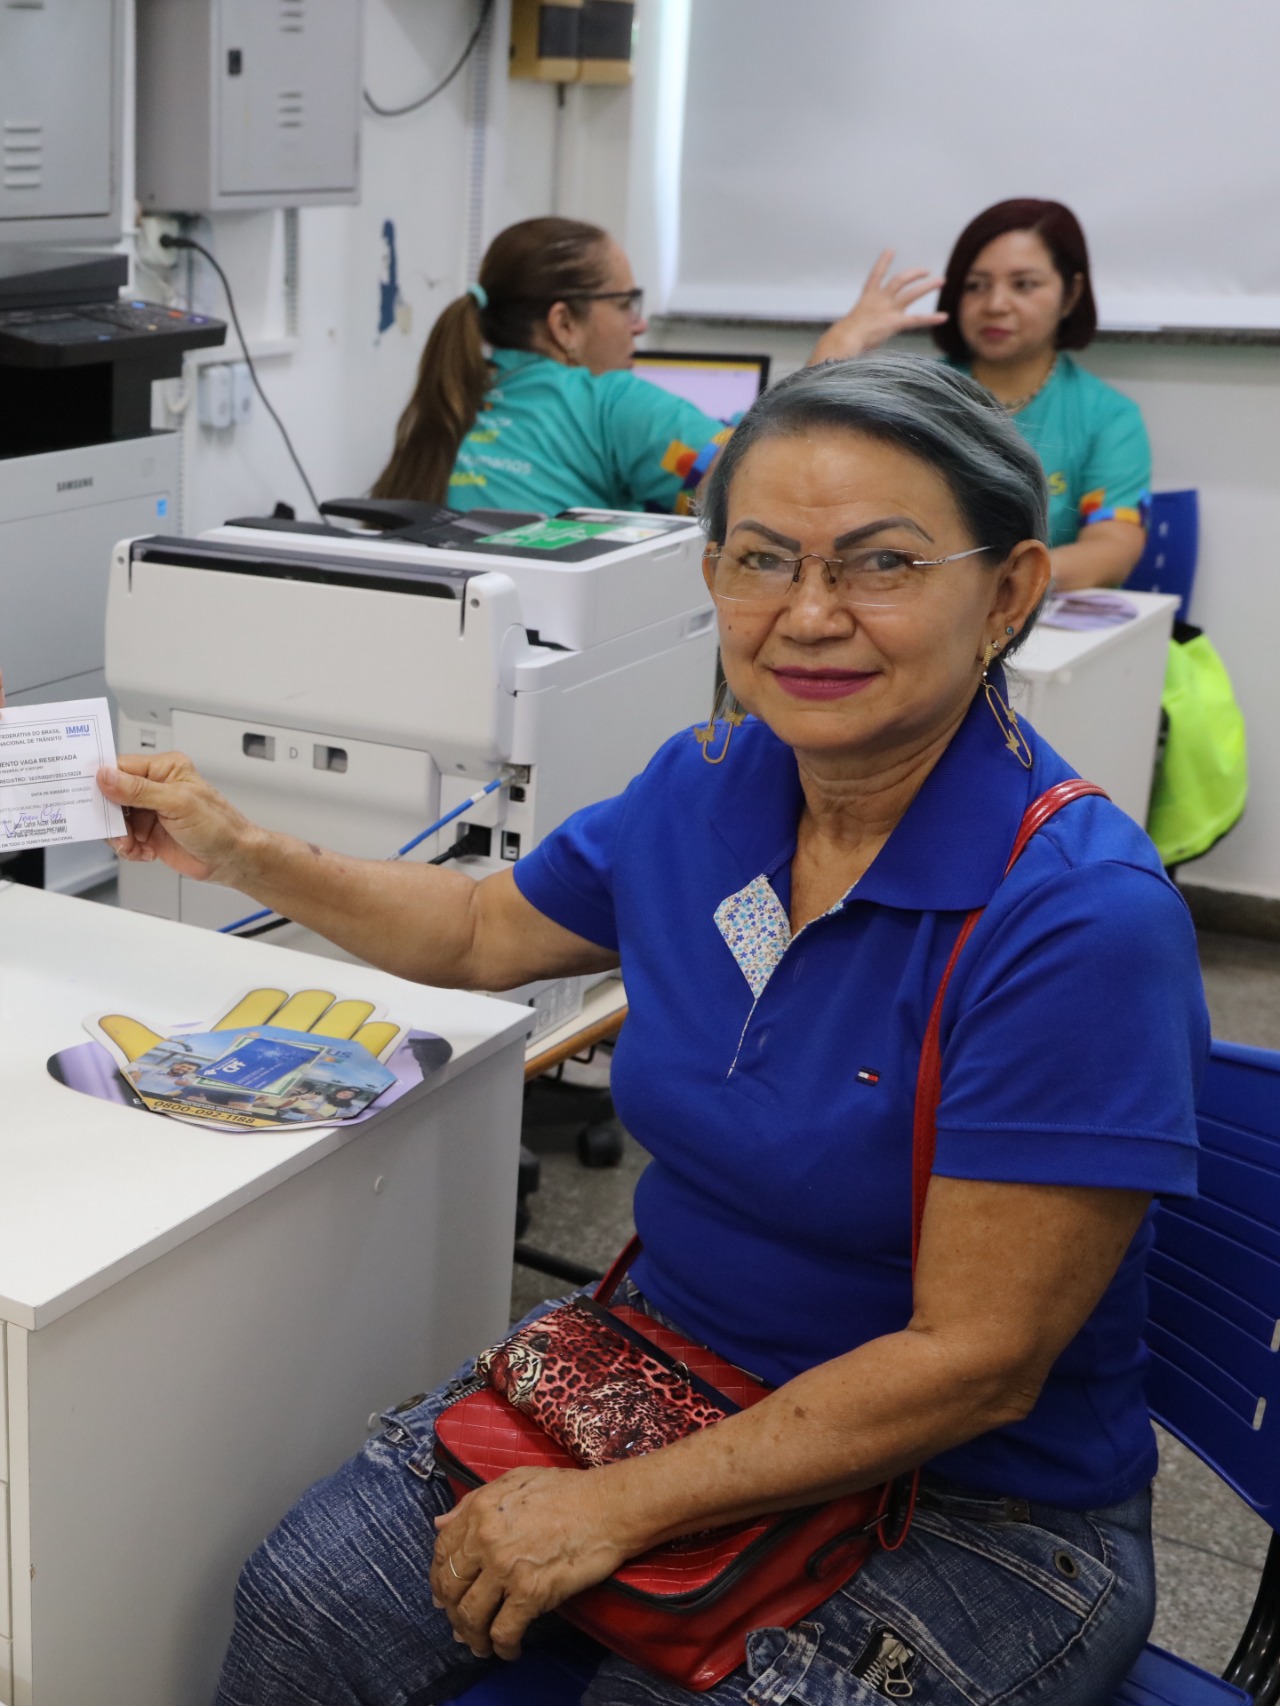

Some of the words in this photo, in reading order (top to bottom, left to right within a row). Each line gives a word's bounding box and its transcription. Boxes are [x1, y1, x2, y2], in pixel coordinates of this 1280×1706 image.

[56, 477, 93, 492] SAMSUNG
[0, 731, 31, 740] FEDERATIVA
[65, 724, 90, 735] IMMU
[0, 739, 26, 747] NACIONAL
[36, 735, 62, 743] TRÂNSITO
[289, 746, 299, 759] D
[20, 758, 38, 766] VAGA
[38, 754, 77, 764] RESERVADA
[153, 1100, 256, 1124] 0800-092-1188
